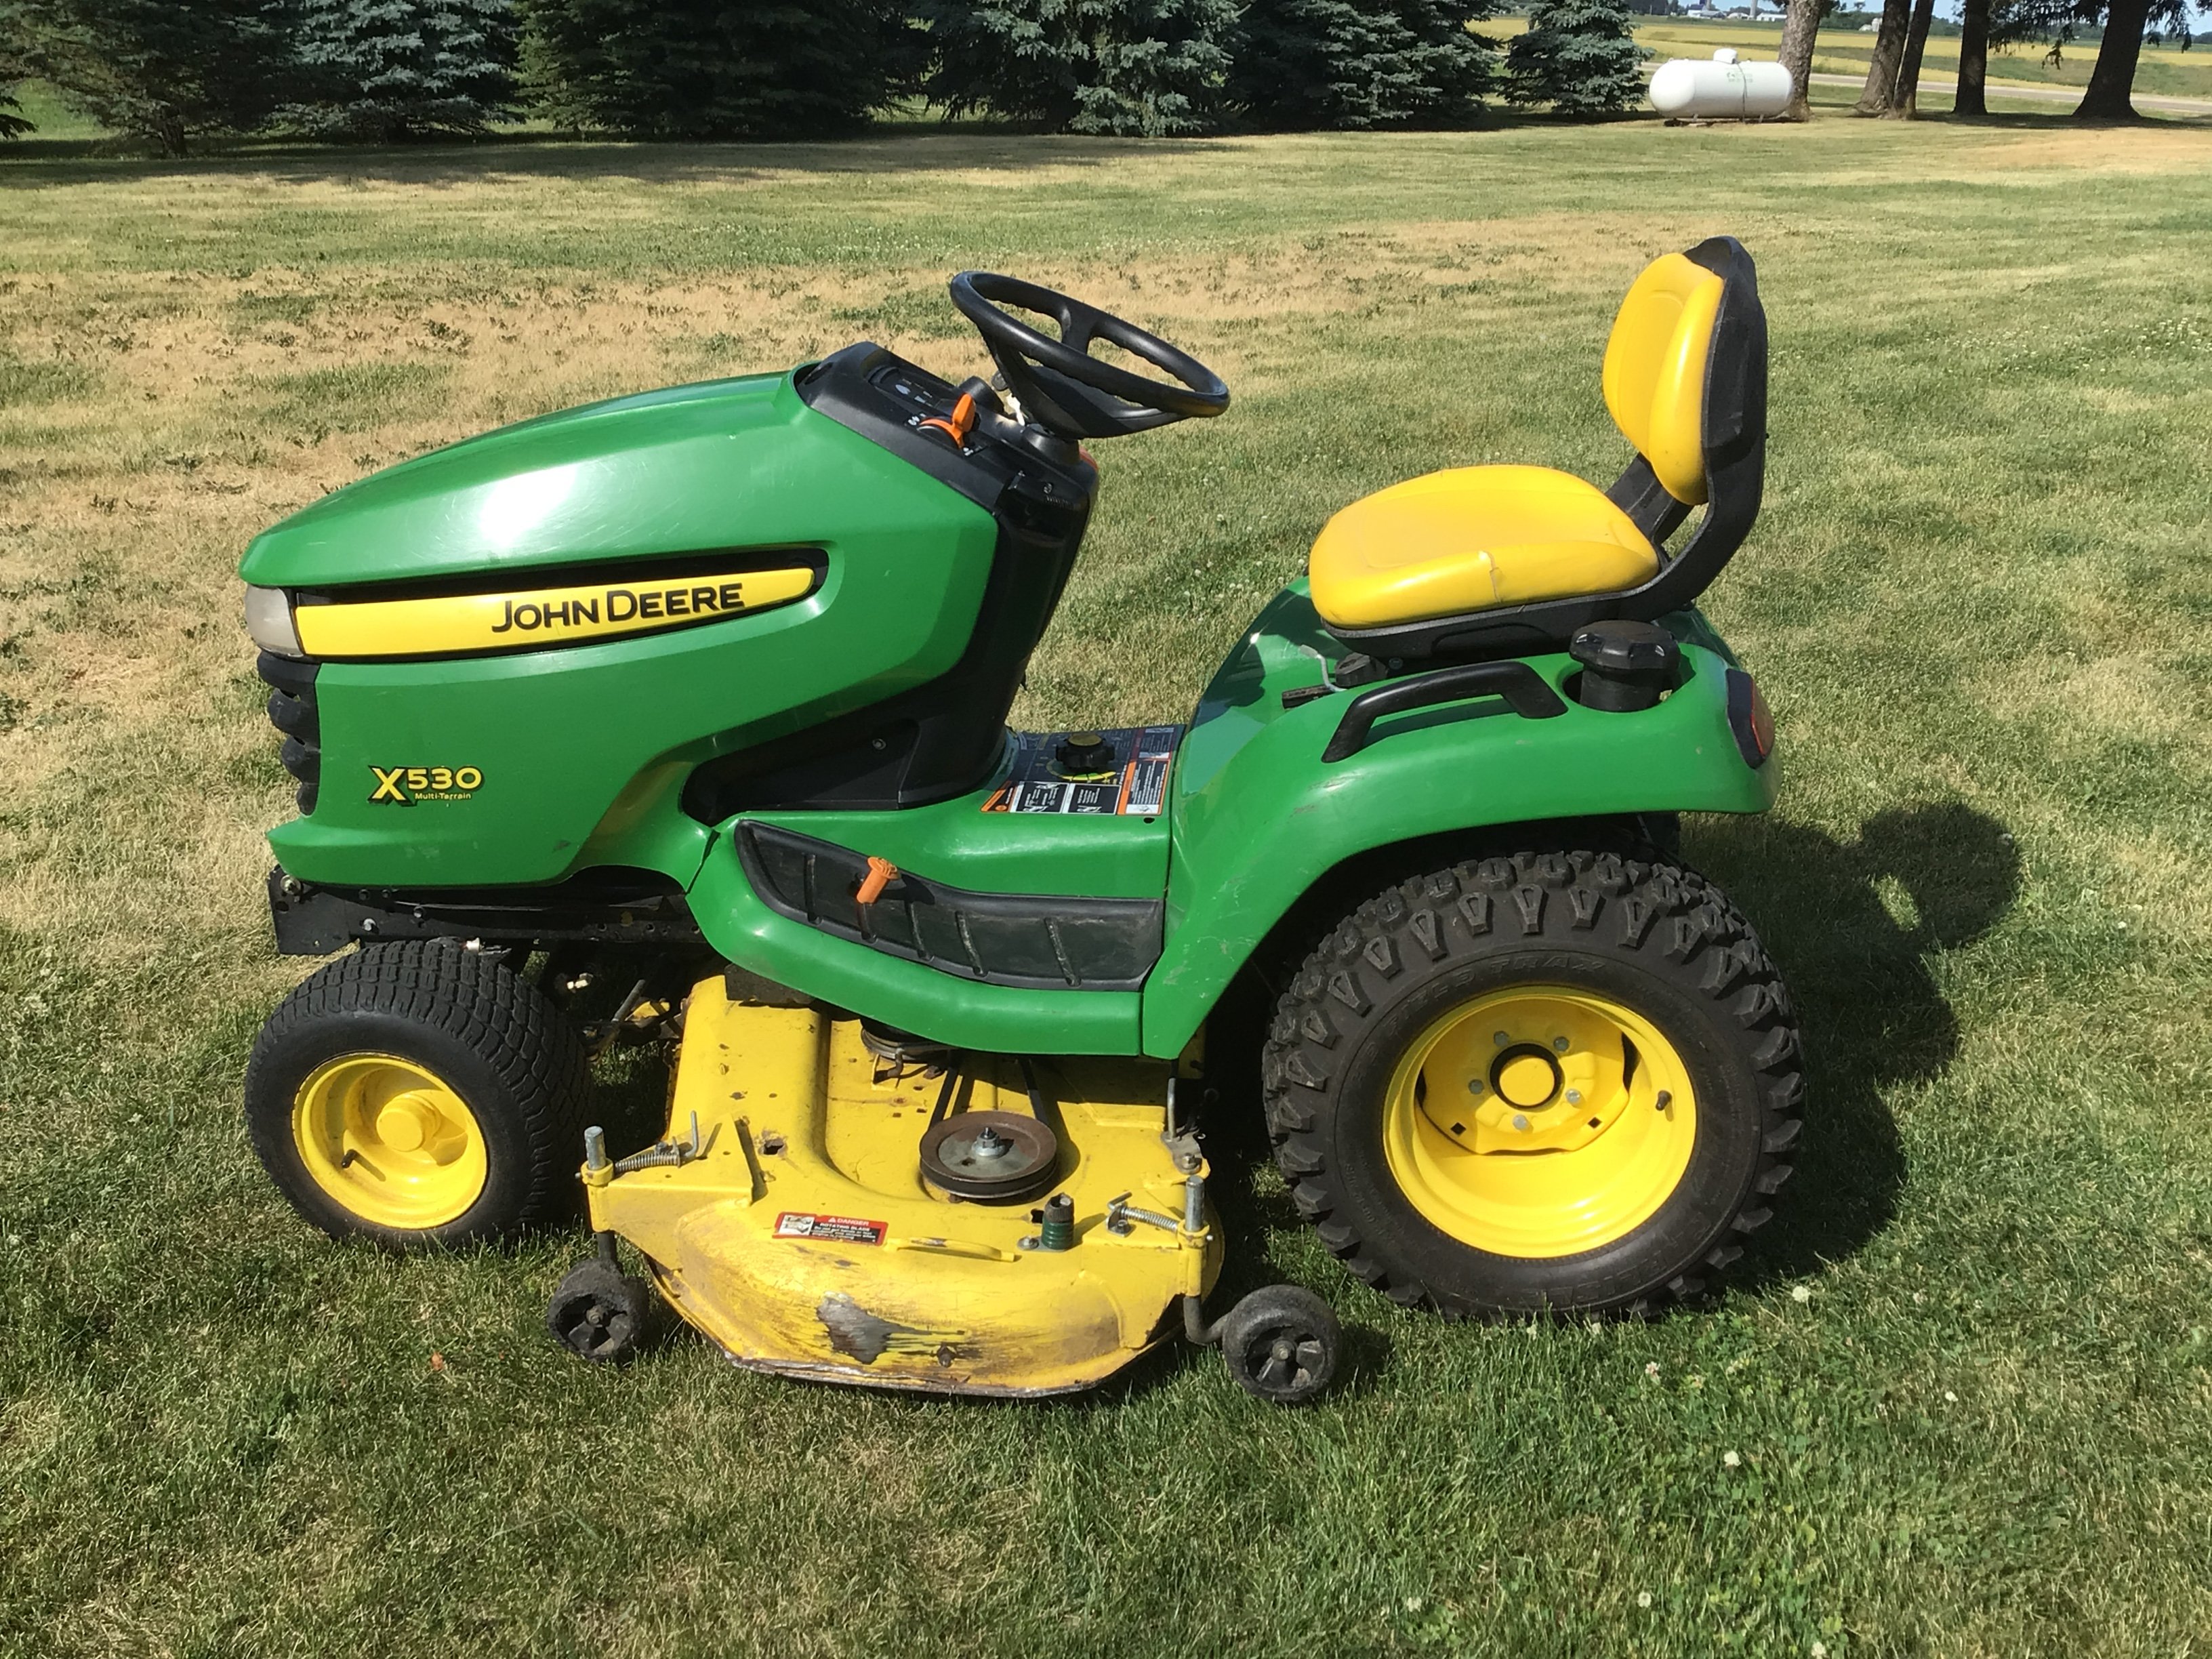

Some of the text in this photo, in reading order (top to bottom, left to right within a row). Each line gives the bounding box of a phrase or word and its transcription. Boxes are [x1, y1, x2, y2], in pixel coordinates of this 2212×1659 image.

[492, 583, 744, 633] JOHN DEERE
[369, 766, 484, 805] X530
[415, 792, 472, 800] Multi-Terrain
[837, 1218, 869, 1226] DANGER
